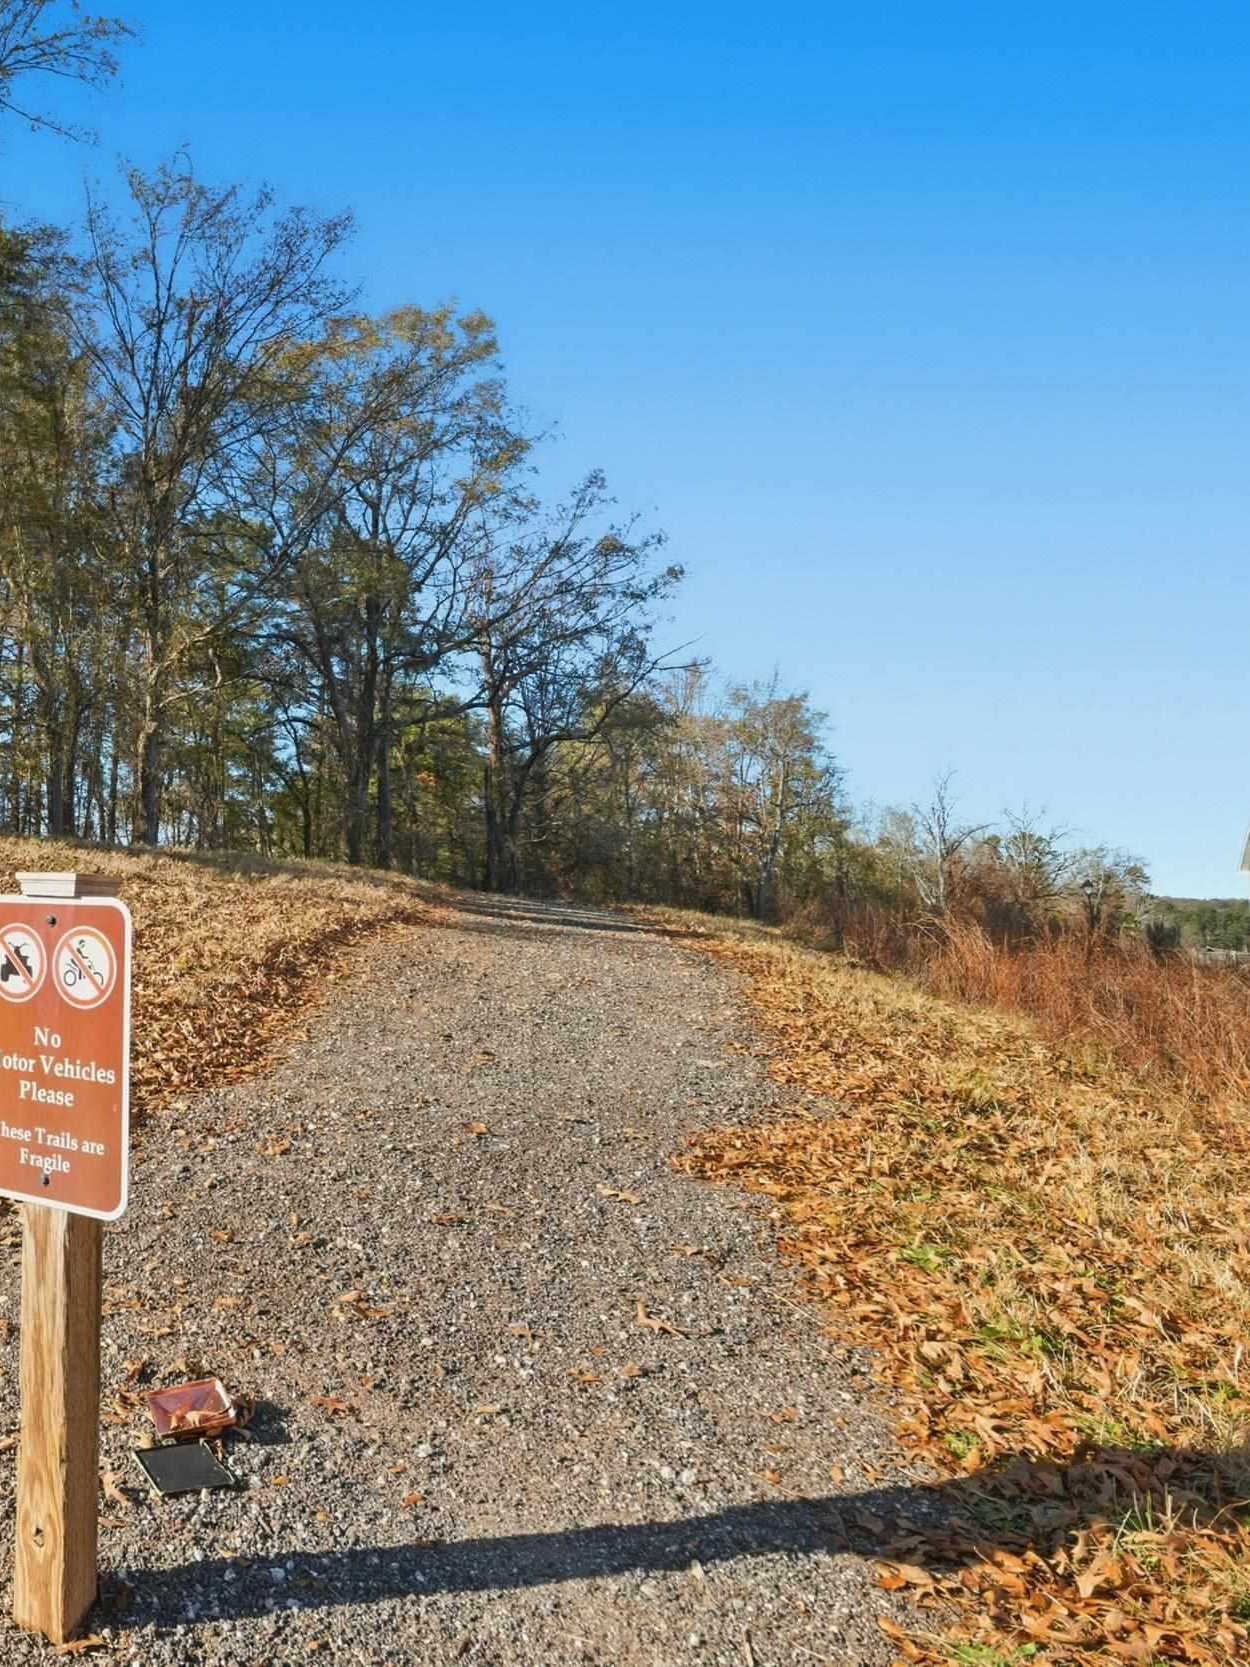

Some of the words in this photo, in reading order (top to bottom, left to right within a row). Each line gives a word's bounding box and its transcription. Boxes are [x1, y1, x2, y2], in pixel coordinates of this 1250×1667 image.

[33, 1026, 61, 1048] No
[40, 1055, 115, 1085] Vehicles
[19, 1080, 74, 1106] Please
[35, 1127, 79, 1151] Trails
[81, 1138, 105, 1155] are
[20, 1147, 70, 1174] Fragile
